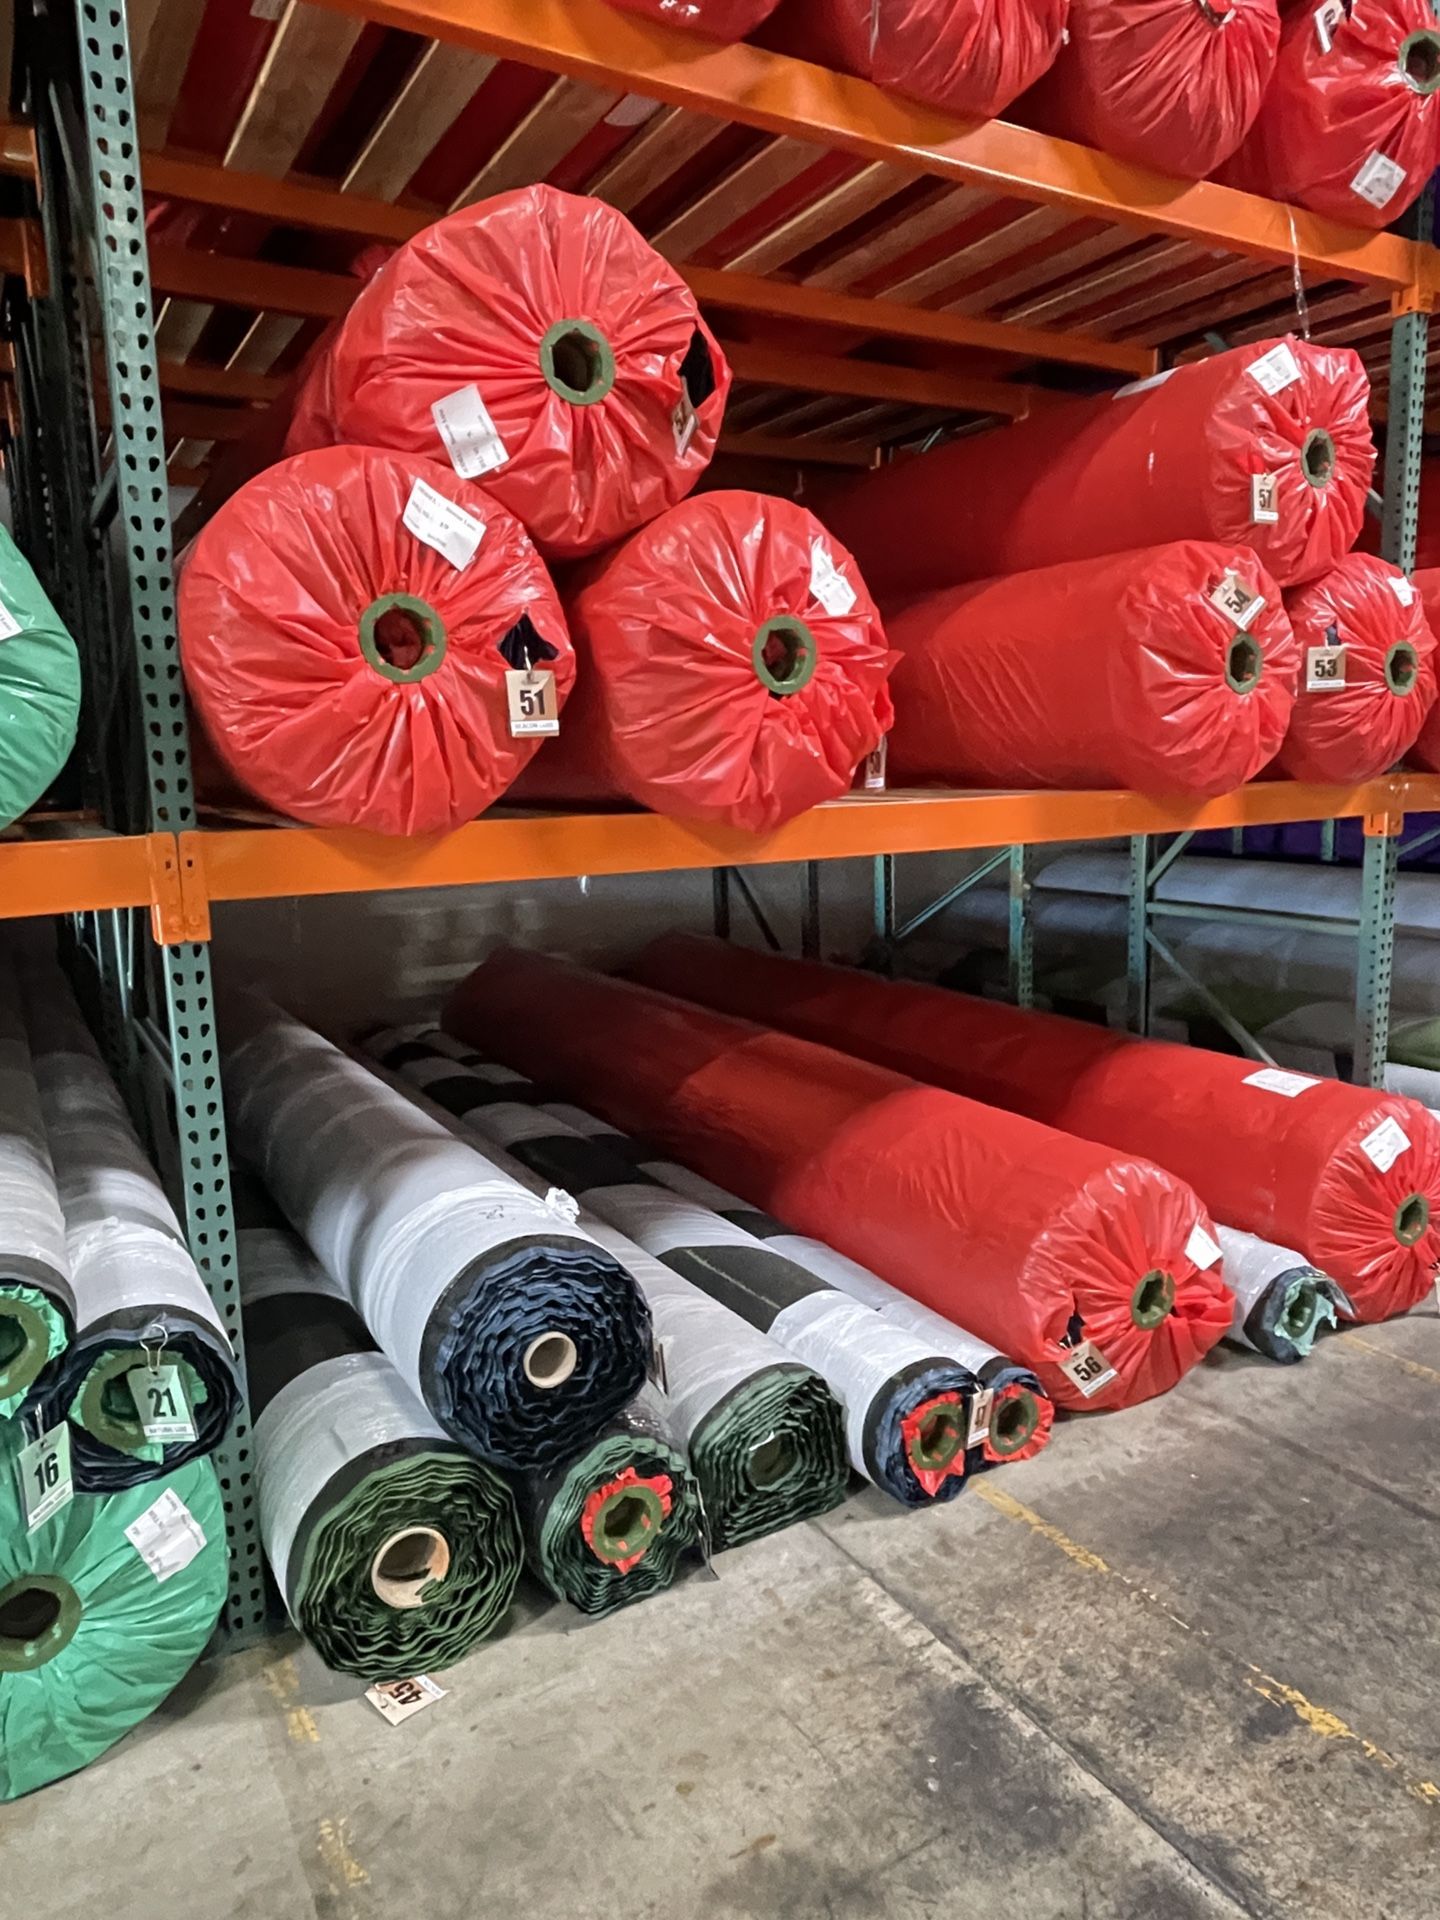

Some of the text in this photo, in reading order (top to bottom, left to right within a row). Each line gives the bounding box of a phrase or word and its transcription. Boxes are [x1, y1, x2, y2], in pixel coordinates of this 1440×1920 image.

[1259, 489, 1272, 509] 57
[1224, 588, 1251, 614] 54
[1315, 659, 1338, 678] 53
[520, 690, 546, 716] 51
[1073, 1355, 1103, 1381] 56
[147, 1387, 178, 1418] 21
[34, 1452, 59, 1497] 16
[388, 1681, 423, 1706] 45
